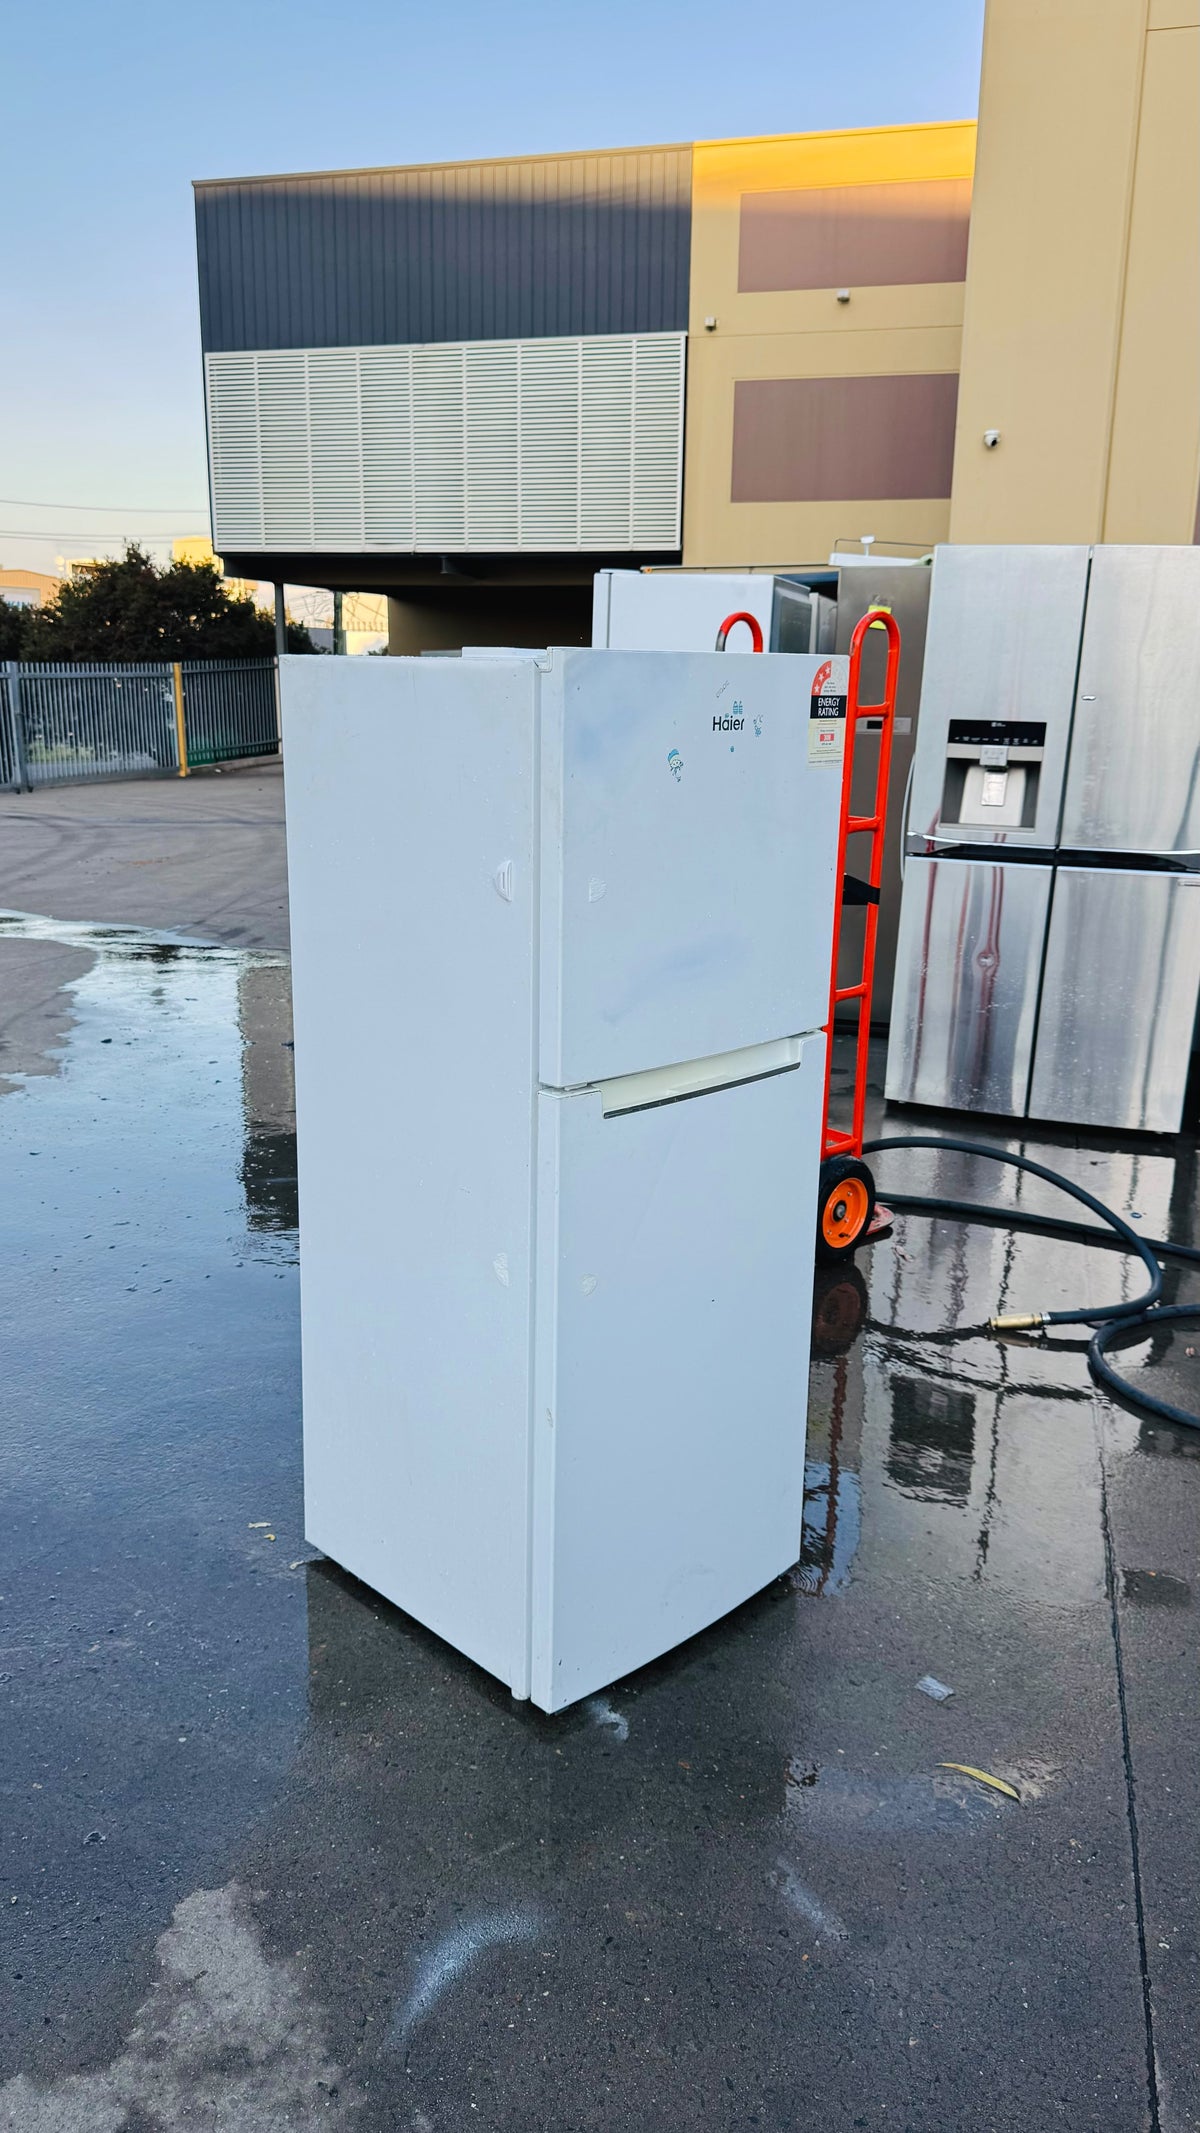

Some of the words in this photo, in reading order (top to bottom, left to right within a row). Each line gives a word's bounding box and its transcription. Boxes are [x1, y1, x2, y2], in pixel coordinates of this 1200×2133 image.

[818, 697, 840, 707] ENERGY
[818, 707, 839, 717] RATING
[712, 715, 745, 731] Haier
